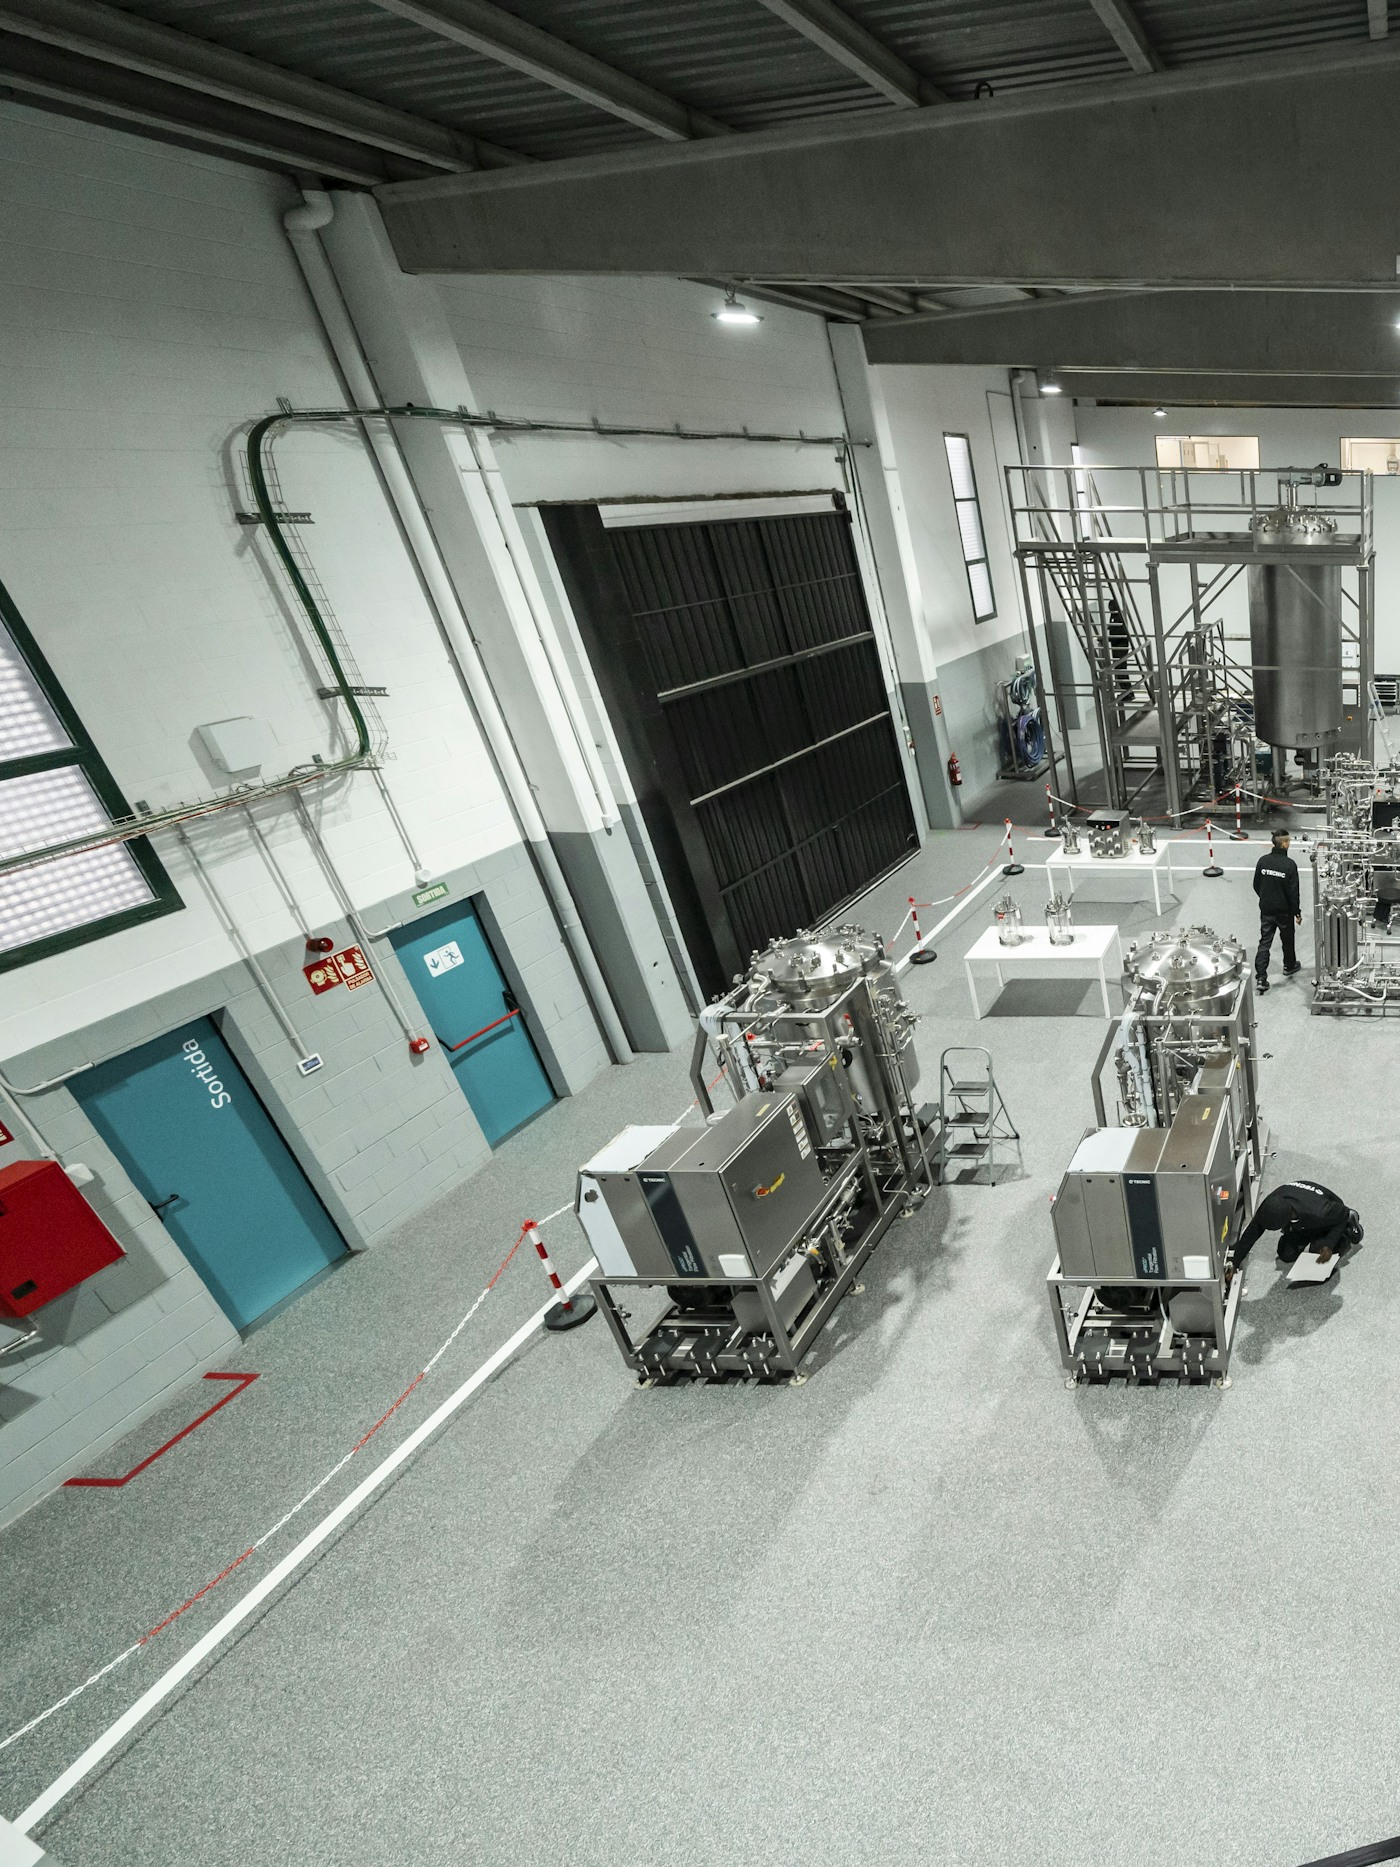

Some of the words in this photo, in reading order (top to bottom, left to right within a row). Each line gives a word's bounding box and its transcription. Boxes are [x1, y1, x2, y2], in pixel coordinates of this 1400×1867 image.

[1265, 869, 1286, 878] TECNIC
[416, 885, 447, 904] SORTIDA
[182, 1038, 232, 1109] Sortida
